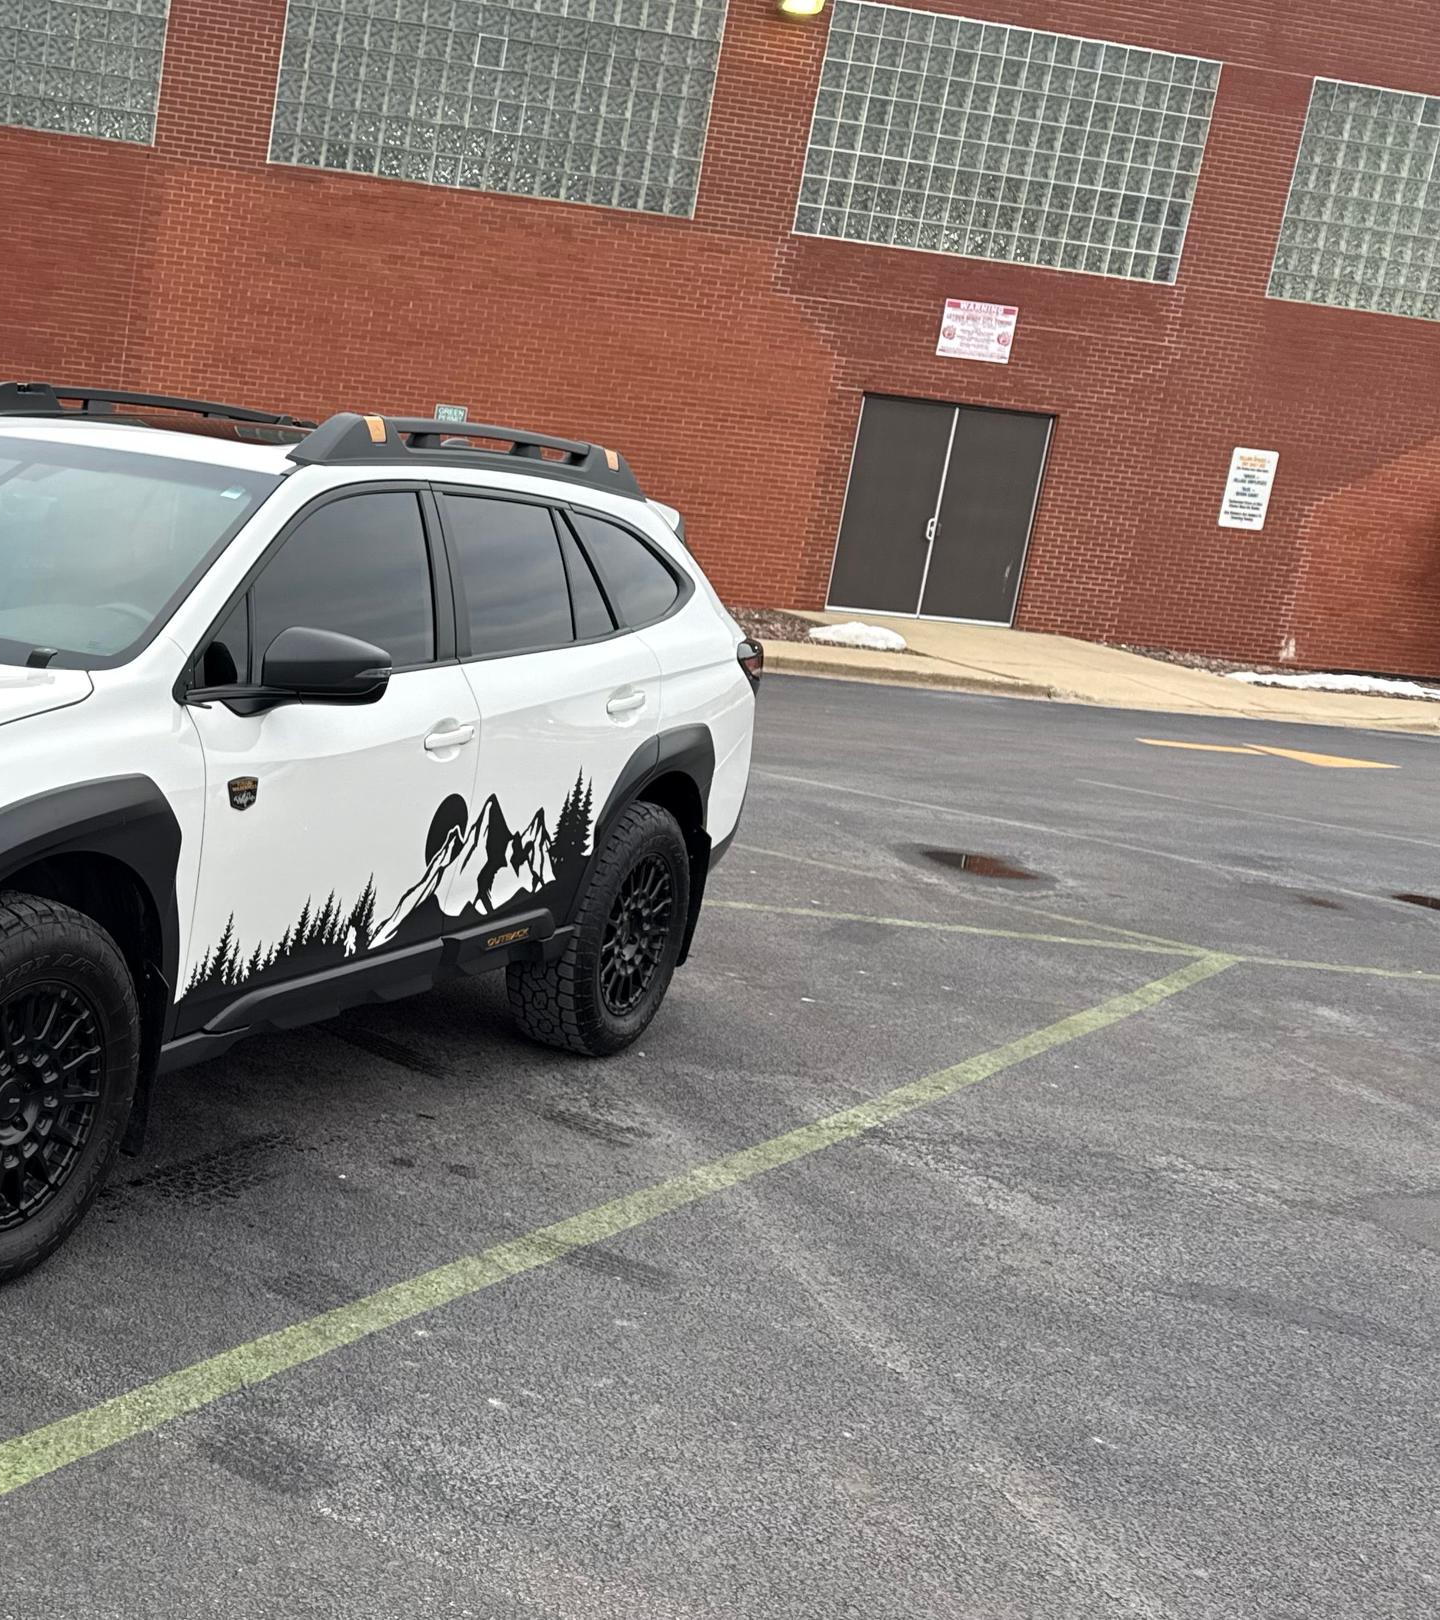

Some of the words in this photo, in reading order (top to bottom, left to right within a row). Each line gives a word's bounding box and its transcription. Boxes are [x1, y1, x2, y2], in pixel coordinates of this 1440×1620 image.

[960, 302, 1003, 315] WARNING
[438, 407, 464, 417] GREEN
[487, 928, 529, 946] OUTBACK
